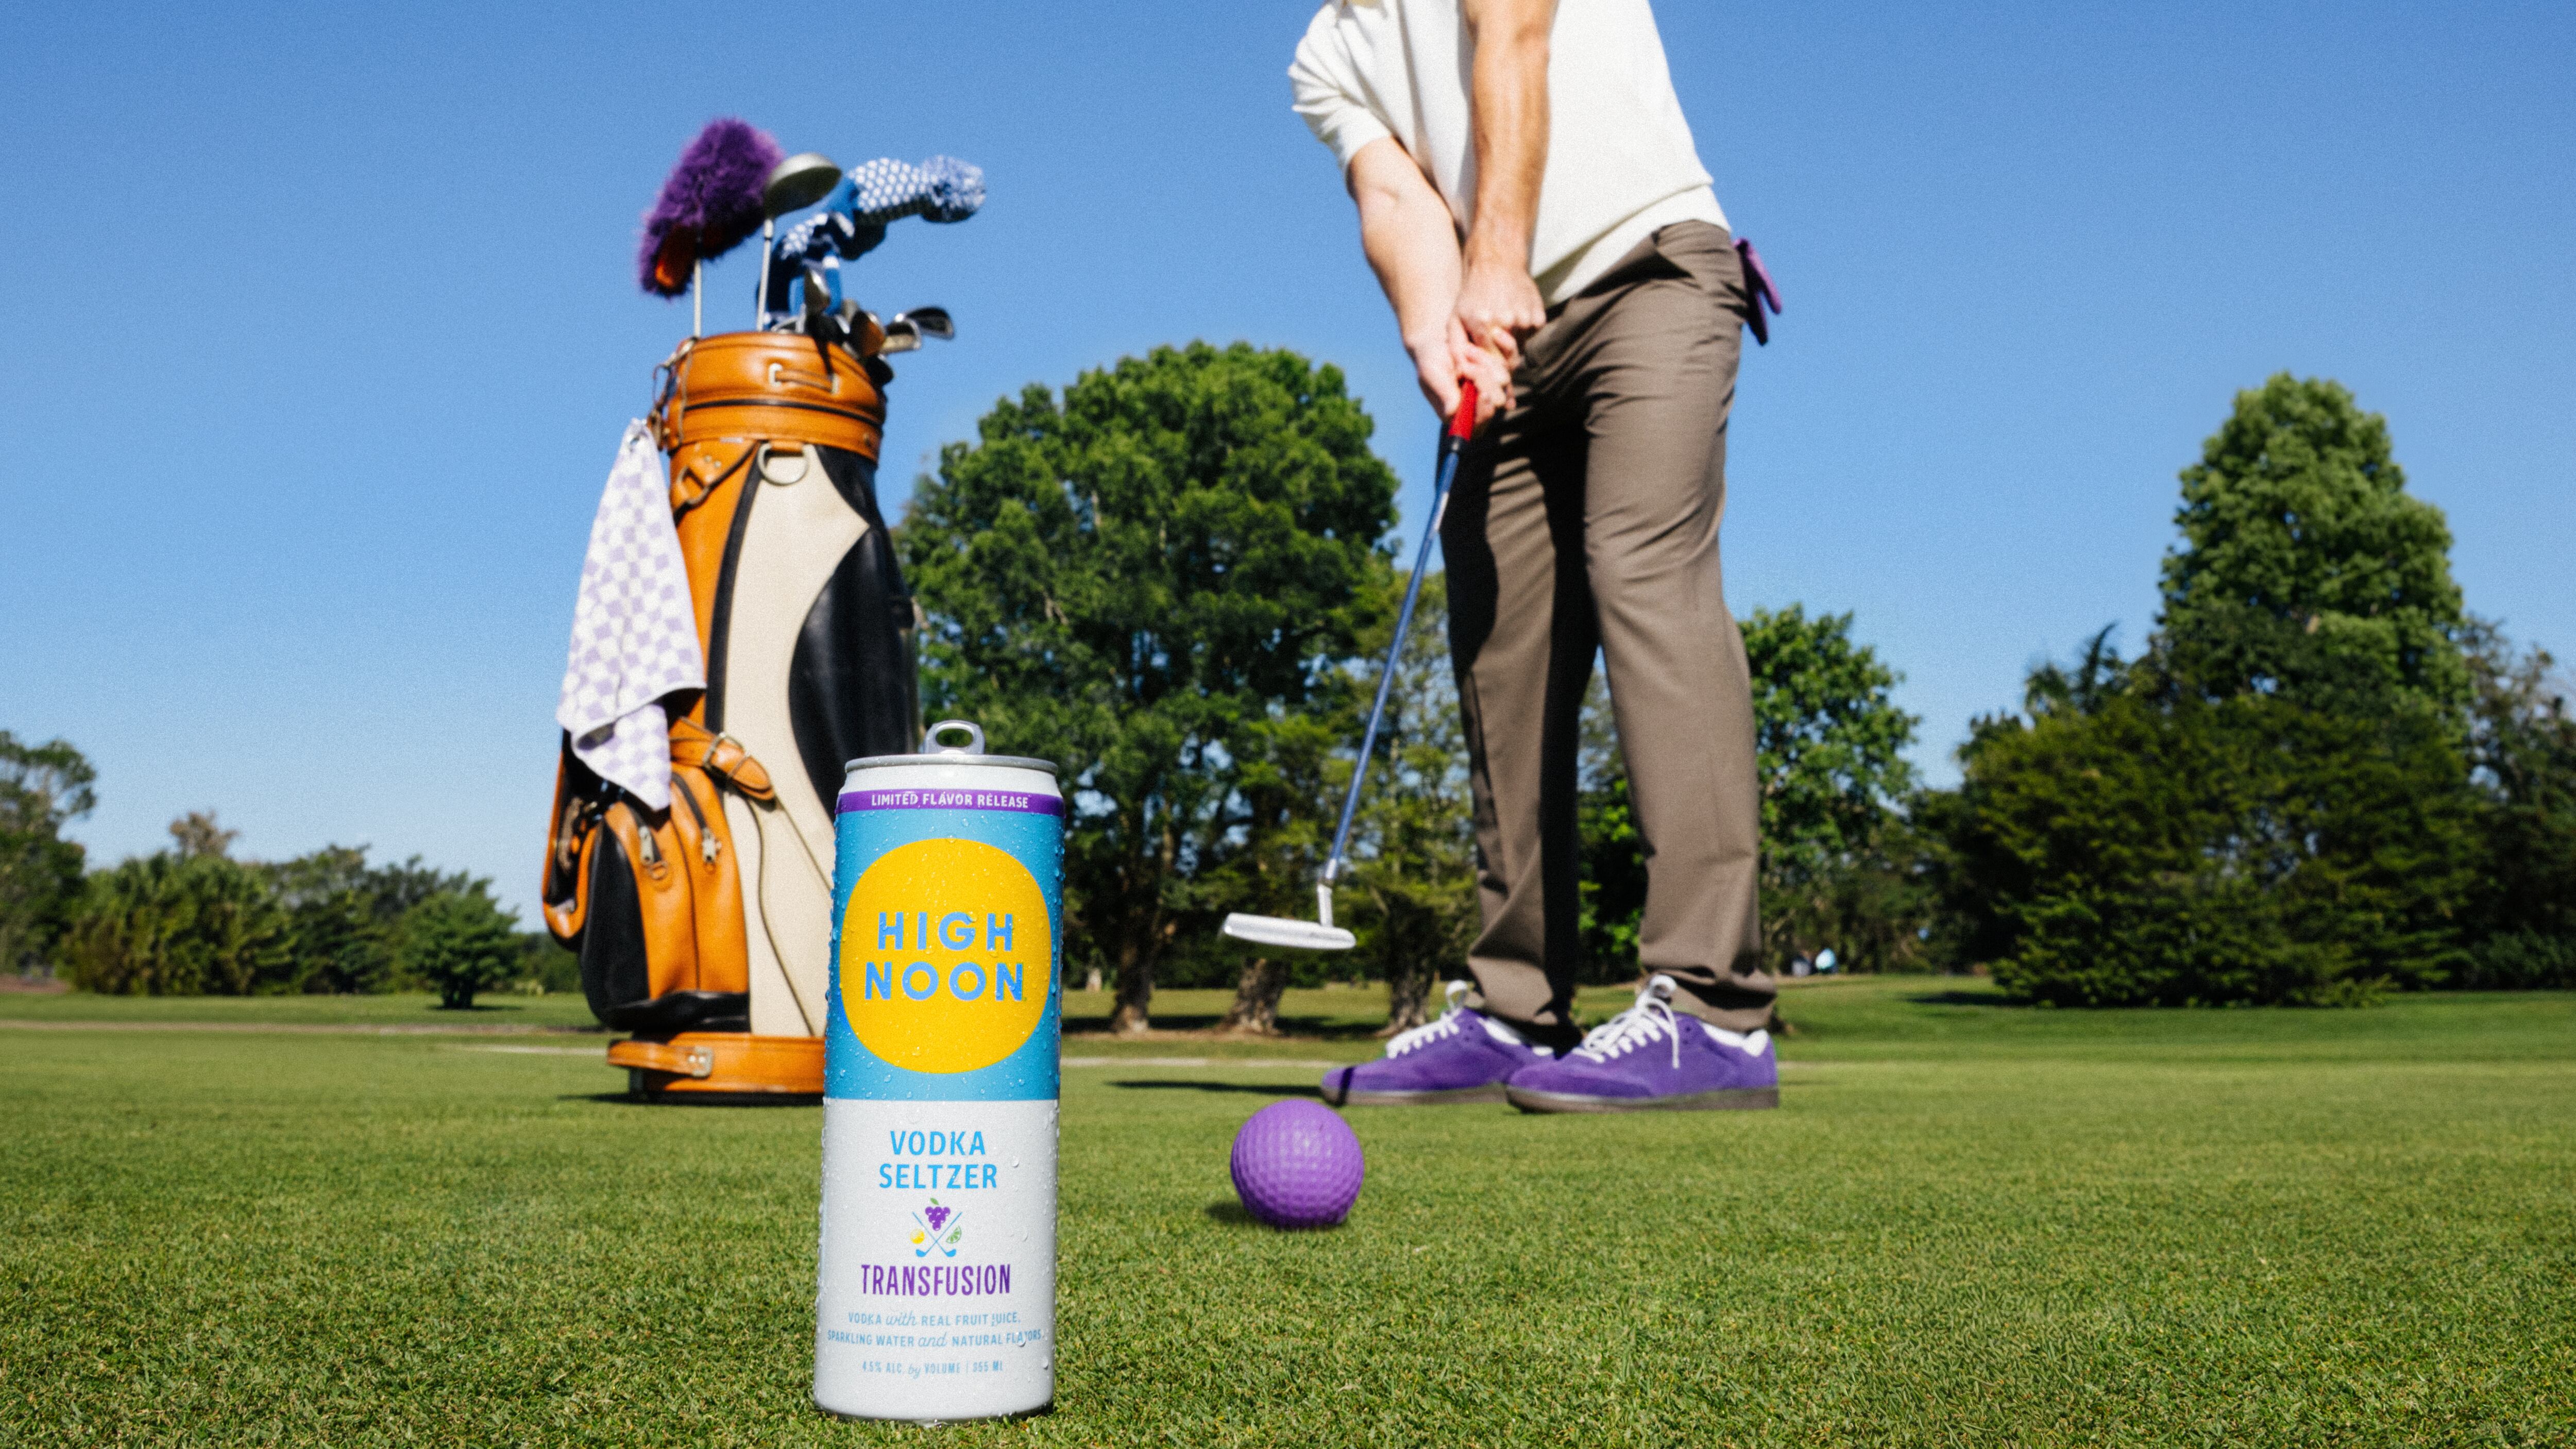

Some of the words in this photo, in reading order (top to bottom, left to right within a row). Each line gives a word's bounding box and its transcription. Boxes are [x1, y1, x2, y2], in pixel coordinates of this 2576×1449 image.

[871, 794, 918, 806] LIMITED
[923, 794, 973, 806] FLAVOR
[977, 794, 1028, 808] RELEASE
[878, 912, 1013, 952] HIGH
[865, 961, 1023, 1001] NOON
[890, 1131, 986, 1155] VODKA
[879, 1163, 997, 1189] SELTZER
[861, 1264, 1010, 1296] TRANSFUSION
[848, 1312, 882, 1325] VODKA
[886, 1310, 917, 1326] with
[921, 1315, 951, 1326] REAL
[955, 1313, 988, 1326] FRUIT
[827, 1329, 872, 1345] SPARKLING
[876, 1335, 914, 1347] WATER
[918, 1332, 947, 1347] and
[952, 1334, 1003, 1346] NATURAL
[908, 1363, 922, 1379] by
[924, 1361, 960, 1374] VOLUME
